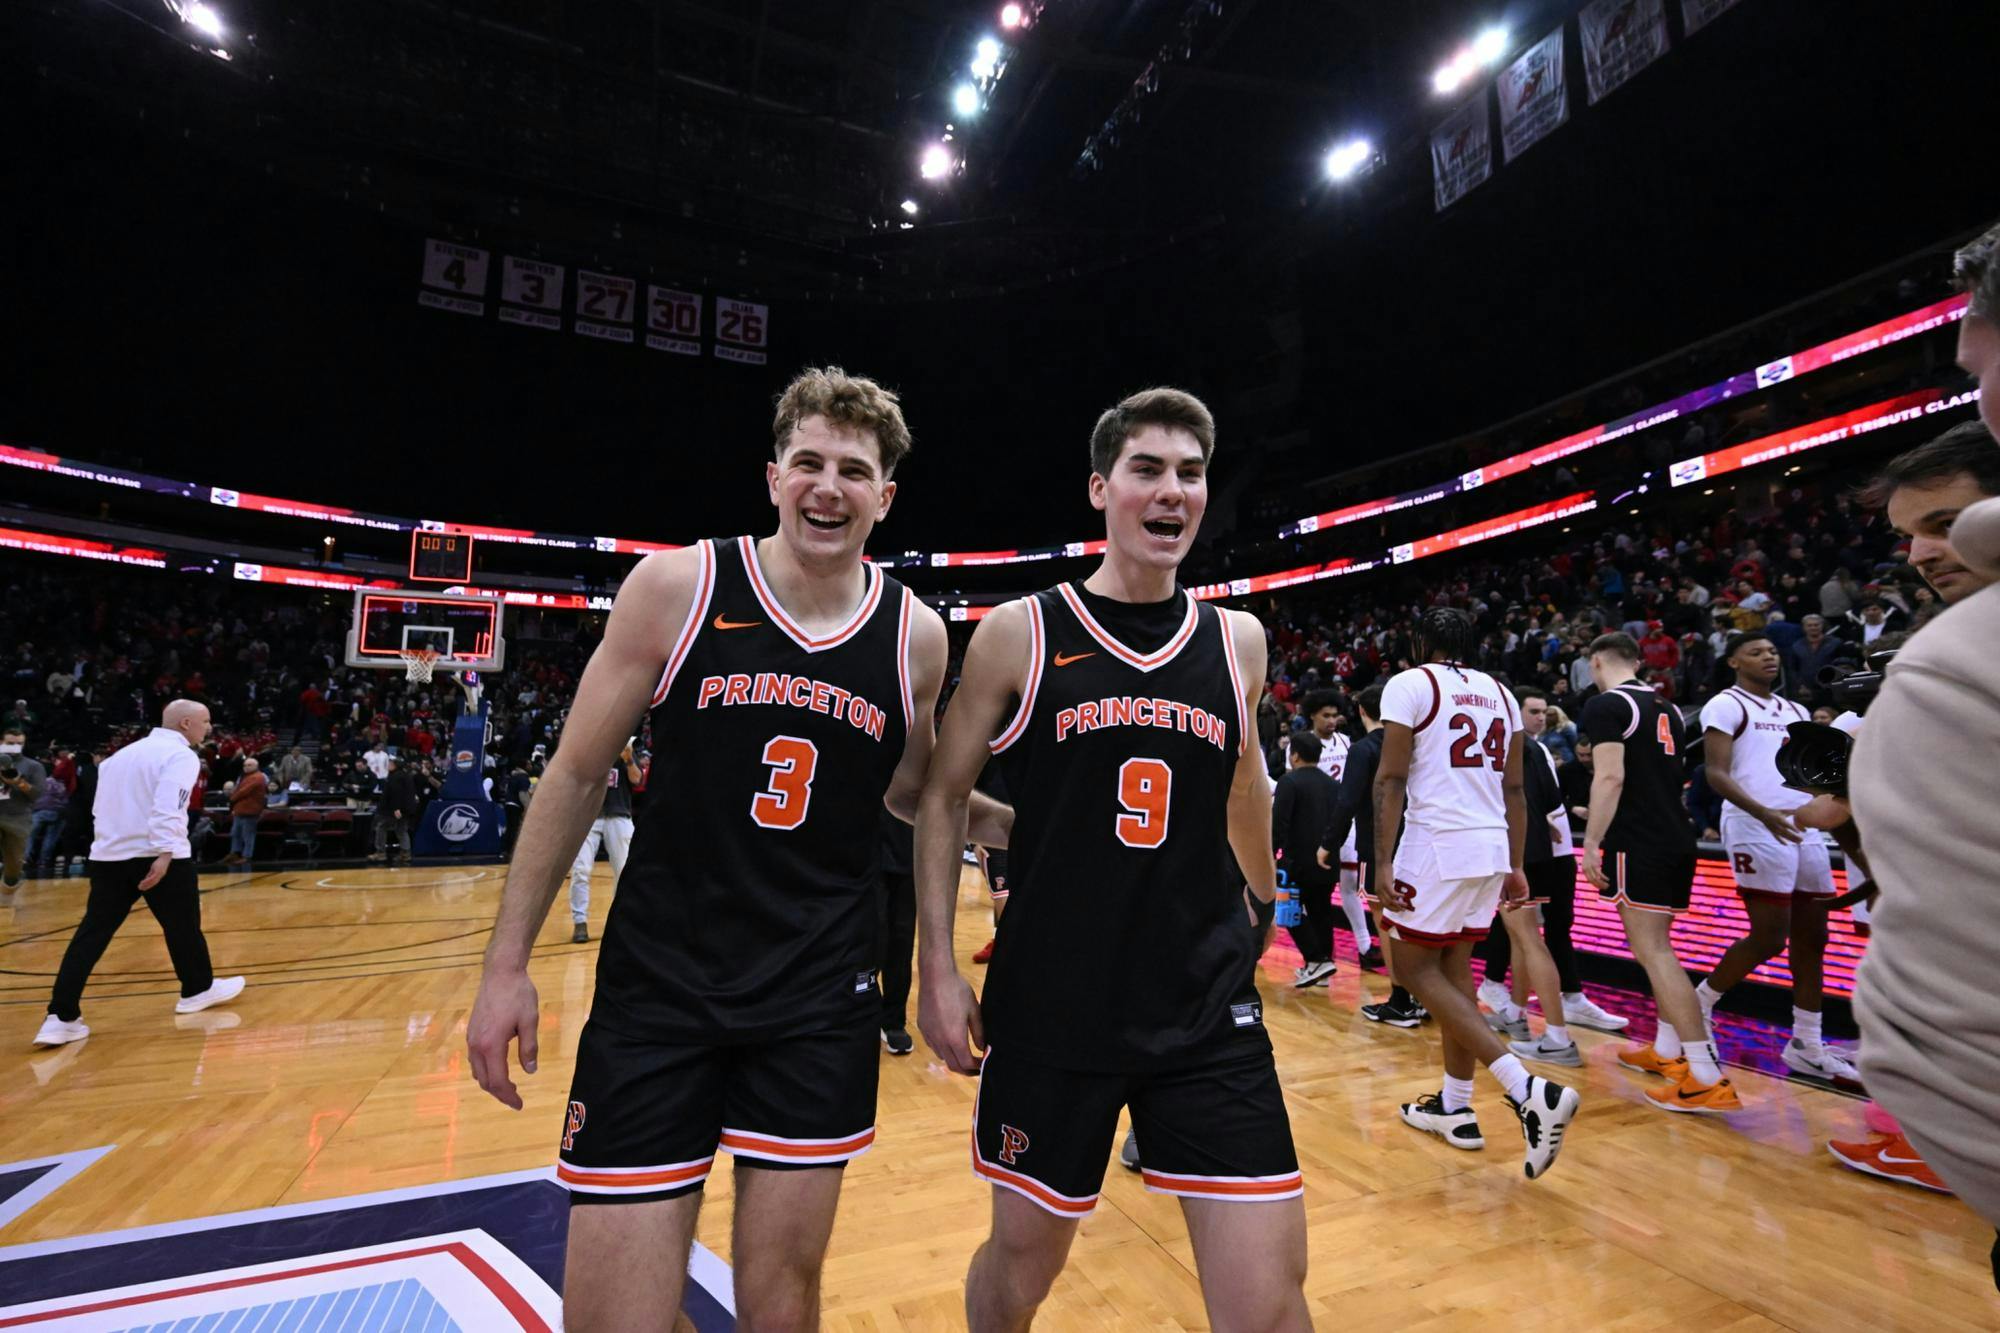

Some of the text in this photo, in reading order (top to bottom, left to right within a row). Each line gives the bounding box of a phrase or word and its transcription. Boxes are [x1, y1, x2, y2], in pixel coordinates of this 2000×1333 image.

[443, 258, 466, 290] 4
[521, 274, 545, 303] 3
[584, 285, 628, 319] 27
[652, 299, 697, 333] 30
[721, 310, 762, 343] 26
[1831, 315, 1944, 363] NEVER FORGET
[1741, 388, 1982, 467] NEVER FORGET TRIBUTE CLASS
[47, 463, 95, 480] TRIBUTE
[95, 472, 142, 489] CLASSIC
[24, 541, 73, 555] FORGET
[74, 548, 121, 562] TRIBUTE
[121, 555, 167, 569] CLASSIC
[697, 672, 886, 743] PRINCETON
[1056, 696, 1226, 751] PRINCETON
[1449, 712, 1506, 772] 24
[1656, 712, 1676, 756] 4
[750, 735, 819, 831] 3
[1115, 757, 1172, 849] 9
[1733, 852, 1756, 874] R
[1394, 879, 1417, 912] R
[562, 1101, 586, 1151] P
[999, 1124, 1029, 1165] P
